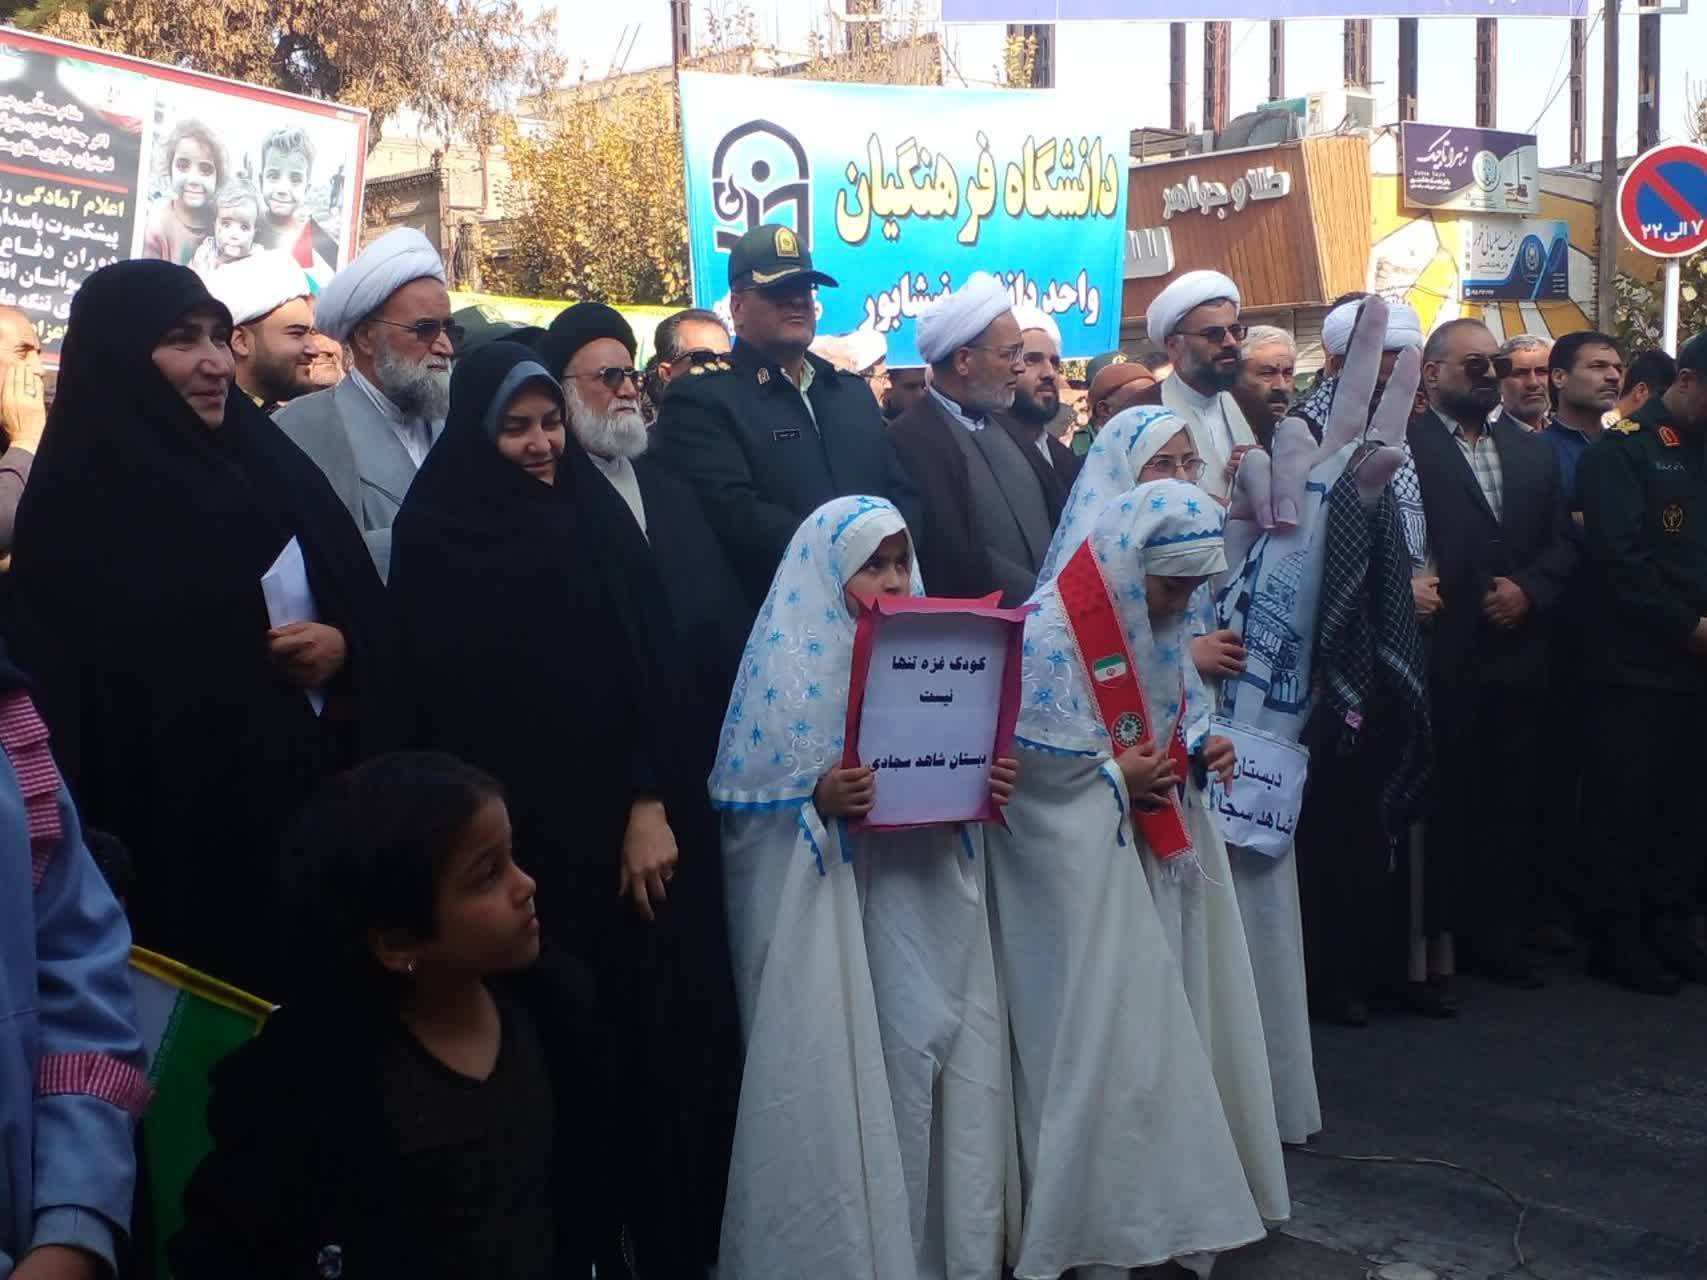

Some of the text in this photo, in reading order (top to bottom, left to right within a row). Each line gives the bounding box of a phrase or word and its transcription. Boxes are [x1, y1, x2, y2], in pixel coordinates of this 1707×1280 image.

[15, 185, 82, 210] آمادگی
[834, 130, 1119, 246] دانشگاه فرهنگیان
[1162, 166, 1291, 221] طلا و جواهر
[83, 195, 125, 218] اعلام
[0, 207, 119, 251] پیشکسوت پاسدا
[1641, 219, 1704, 242] ۷ الی ۲۲
[18, 265, 82, 296] وانان
[1041, 268, 1101, 326] واحد
[892, 656, 986, 674] کودک غزه تنها
[919, 688, 953, 707] نیست
[870, 752, 986, 772] دبستان شاهد سجادی
[1256, 811, 1293, 835] شاهد
